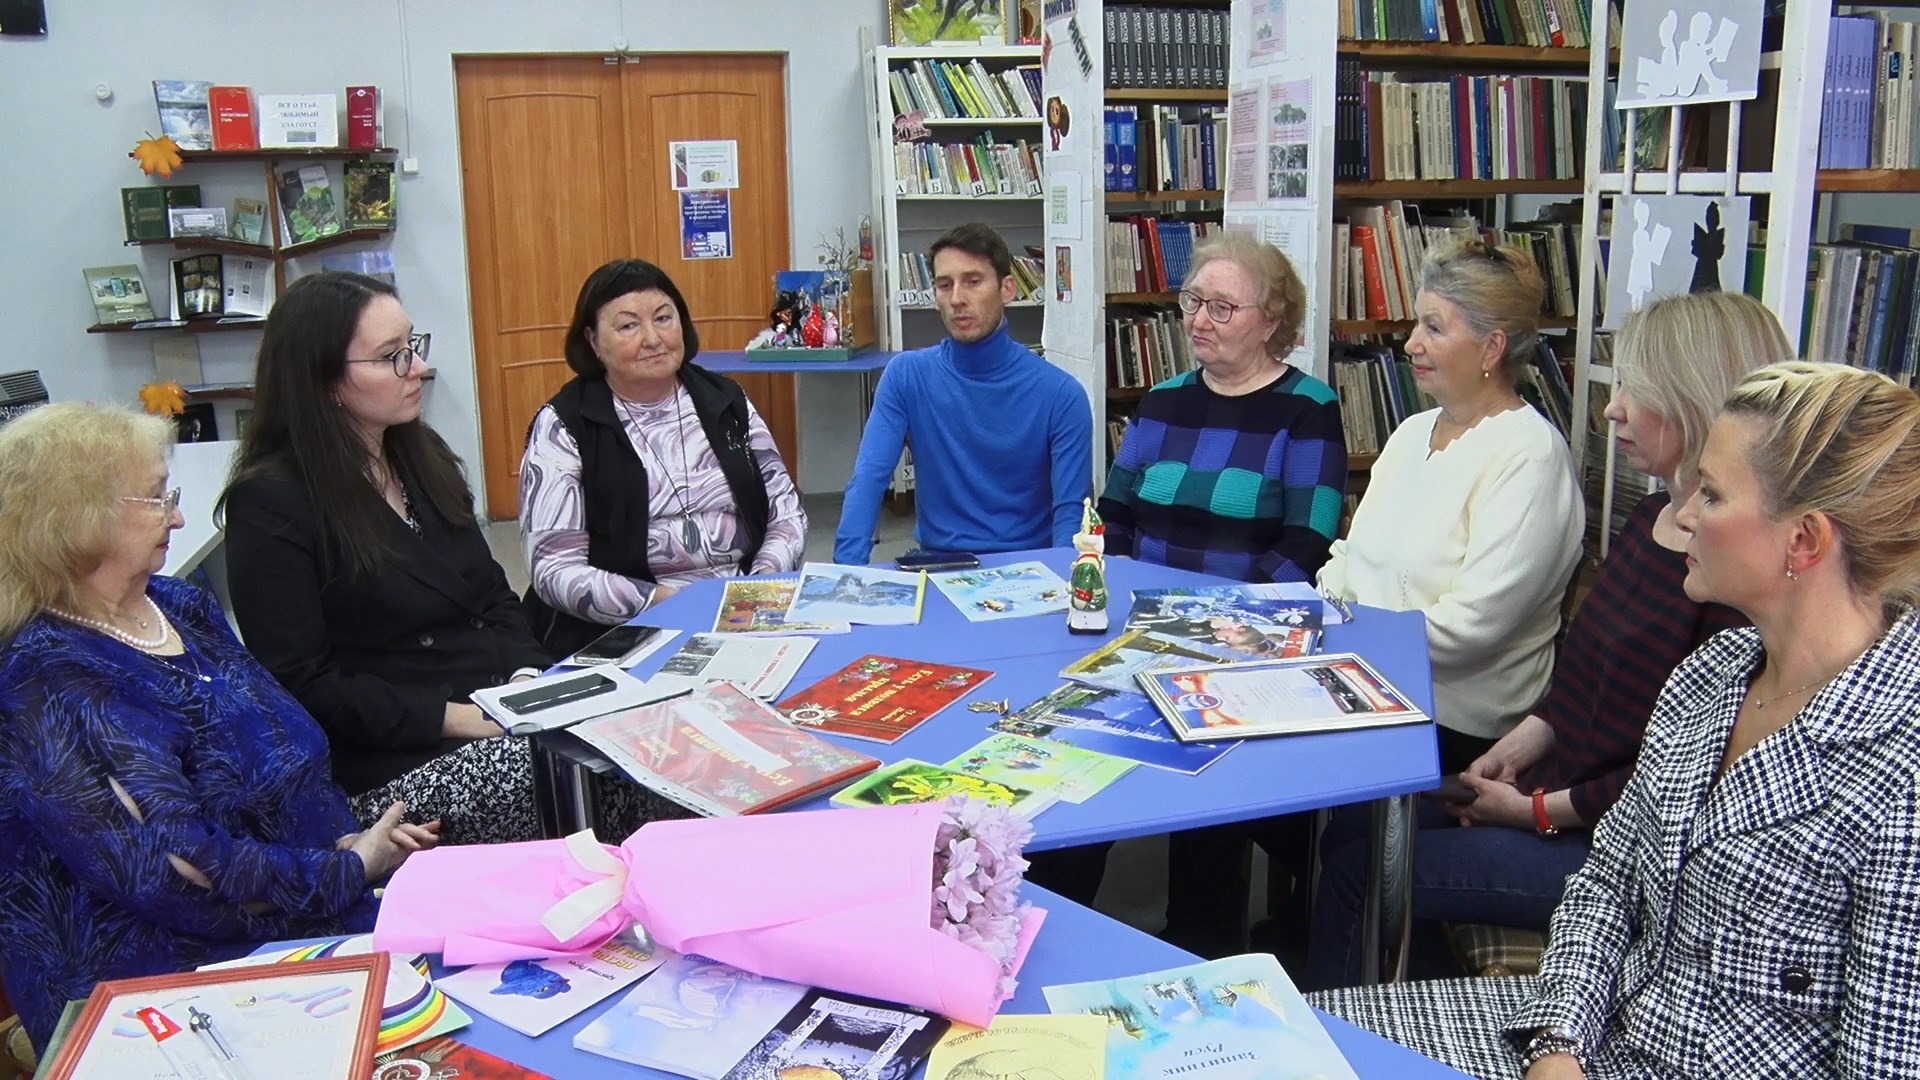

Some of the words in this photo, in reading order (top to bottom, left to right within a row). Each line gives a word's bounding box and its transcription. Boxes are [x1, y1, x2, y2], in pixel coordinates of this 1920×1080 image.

[1068, 16, 1093, 77] РАСТИ!
[902, 668, 935, 687] Есть
[1182, 1043, 1226, 1059] Руси
[1160, 1050, 1260, 1079] Защитник
